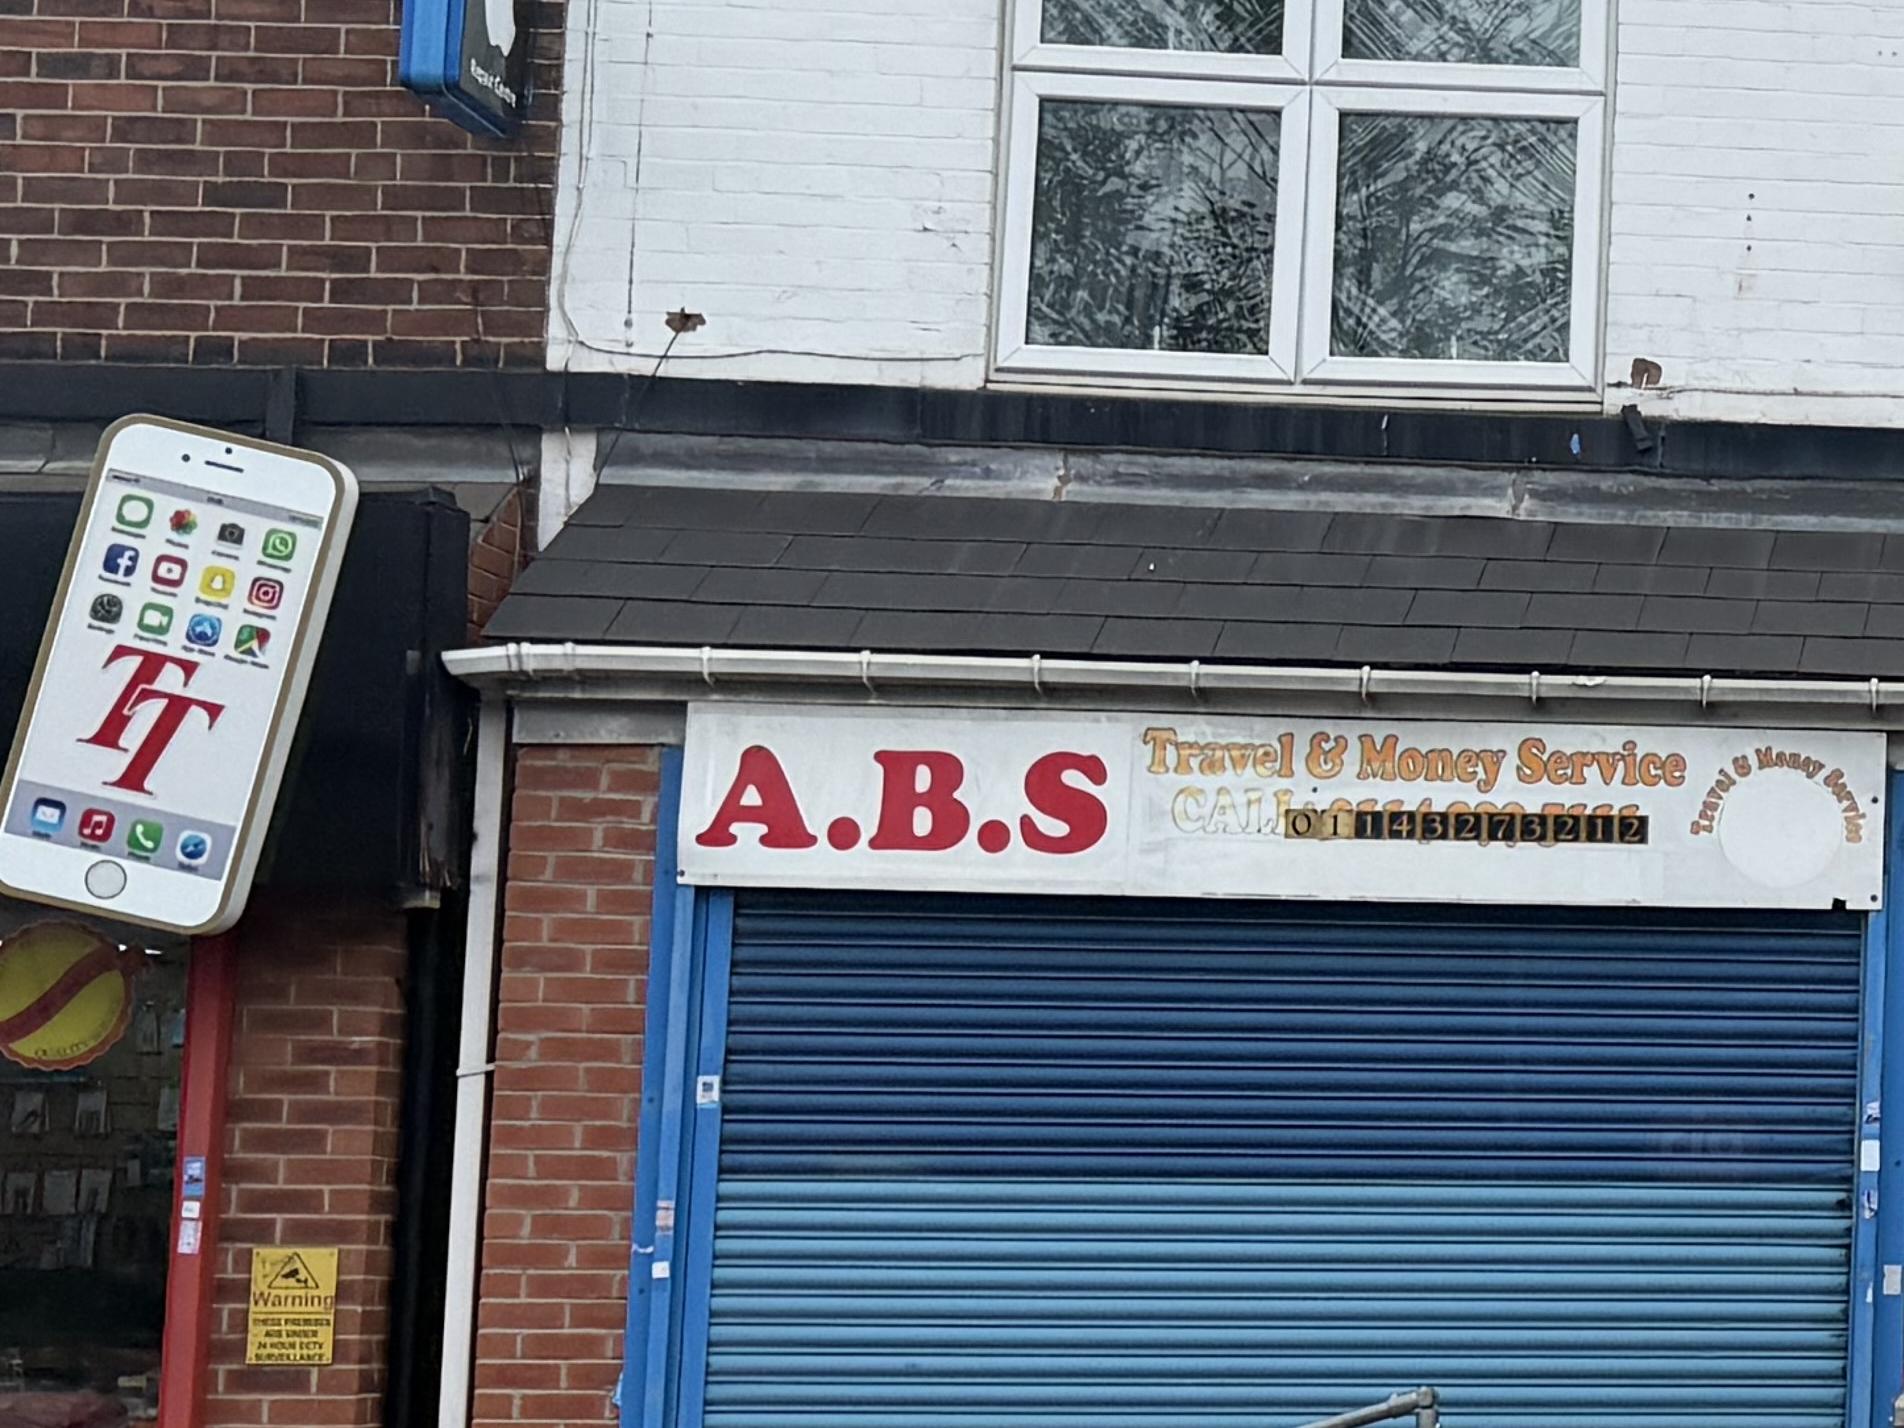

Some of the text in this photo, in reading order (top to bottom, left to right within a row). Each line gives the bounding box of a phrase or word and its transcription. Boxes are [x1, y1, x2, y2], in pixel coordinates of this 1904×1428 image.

[76, 643, 226, 796] TT
[1141, 726, 1687, 793] Travel & Money Service
[695, 744, 1109, 855] A.B.S
[1289, 810, 1644, 844] 01143273212
[1690, 769, 1736, 835] Travel
[1755, 746, 1825, 779] Money
[1823, 768, 1867, 844] Service
[253, 1291, 336, 1312] Warning
